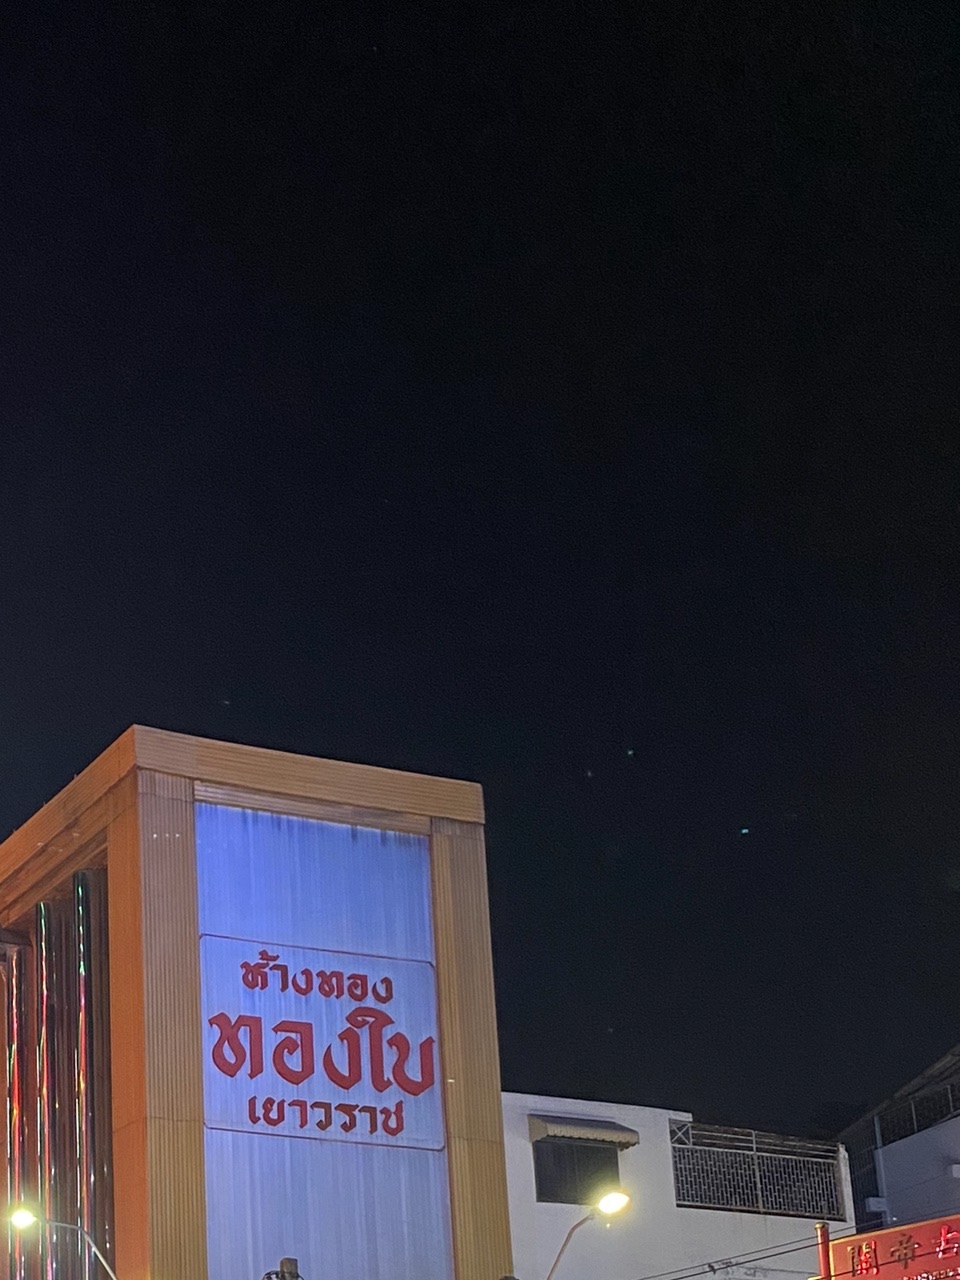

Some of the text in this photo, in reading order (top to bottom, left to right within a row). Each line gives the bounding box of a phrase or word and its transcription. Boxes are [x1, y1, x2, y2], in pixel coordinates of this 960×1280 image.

[240, 949, 394, 1005] ห้างทอง
[207, 1005, 437, 1097] ทองใบ
[247, 1095, 405, 1137] เยาวราช
